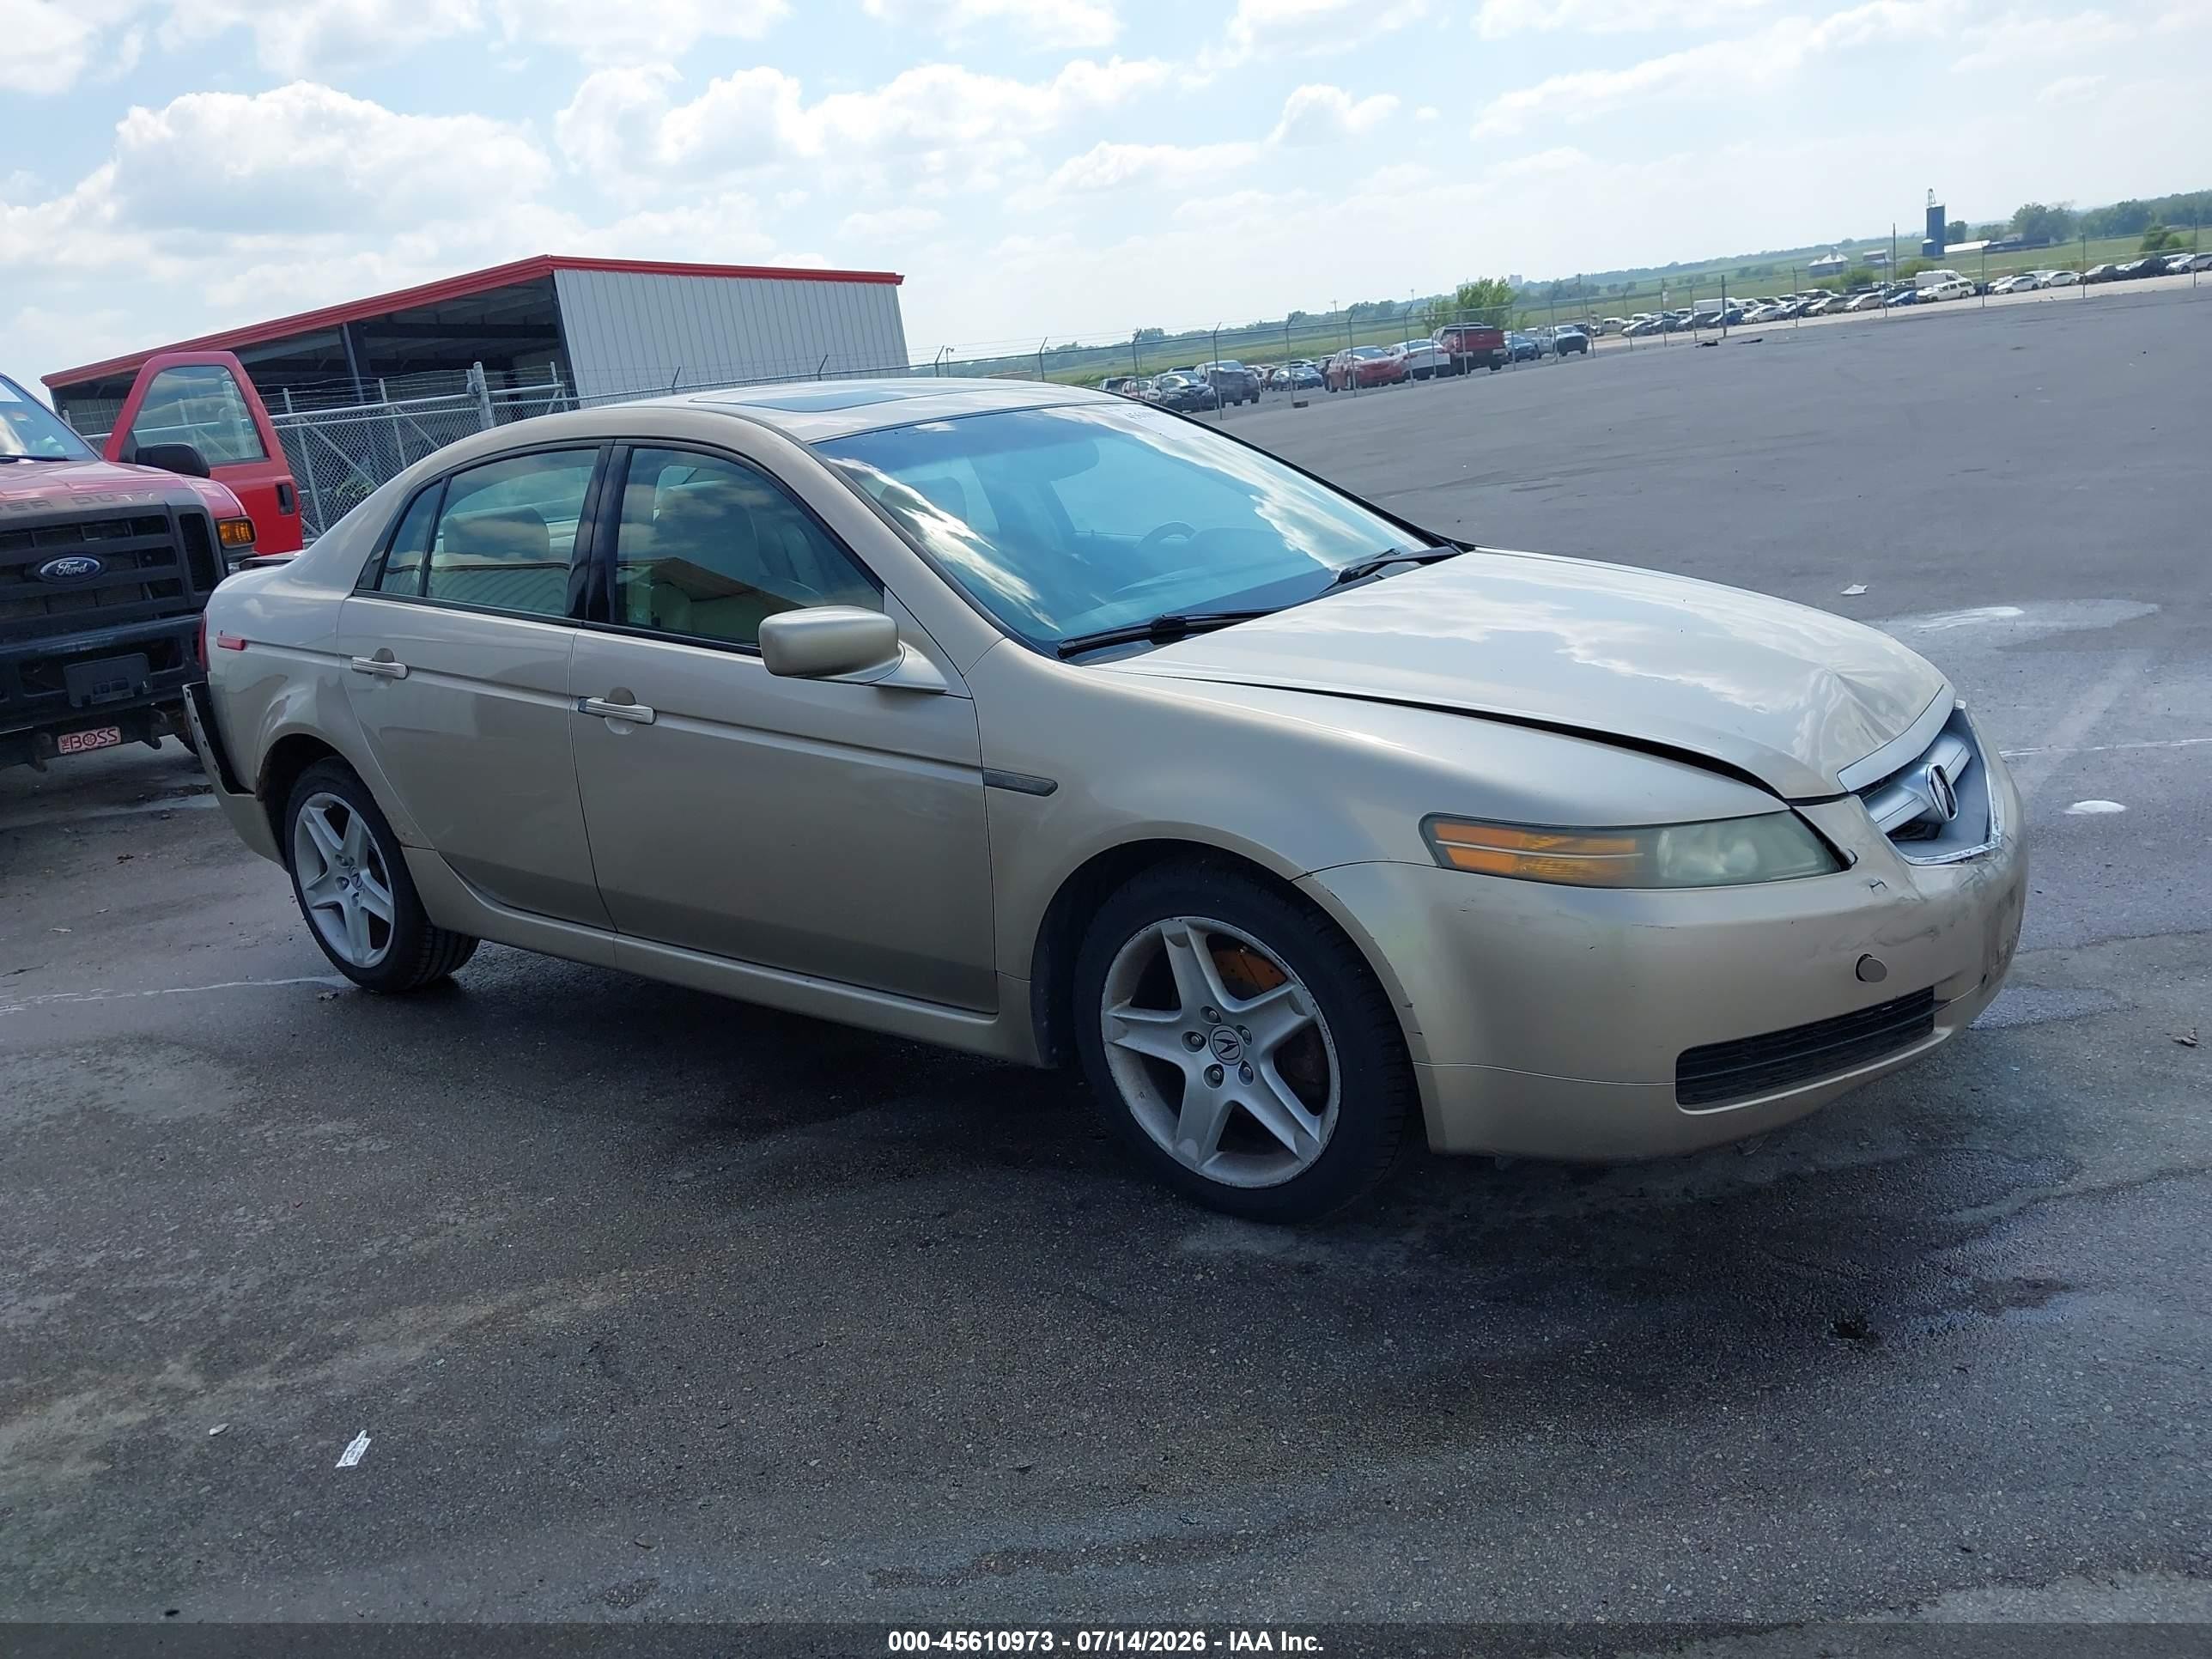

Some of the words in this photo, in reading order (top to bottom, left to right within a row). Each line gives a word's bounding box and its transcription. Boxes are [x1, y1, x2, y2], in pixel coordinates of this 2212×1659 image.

[0, 500, 54, 512] ER
[70, 492, 156, 505] DUTY
[56, 561, 88, 576] Ford
[61, 736, 70, 750] THE
[70, 728, 118, 750] BOSS
